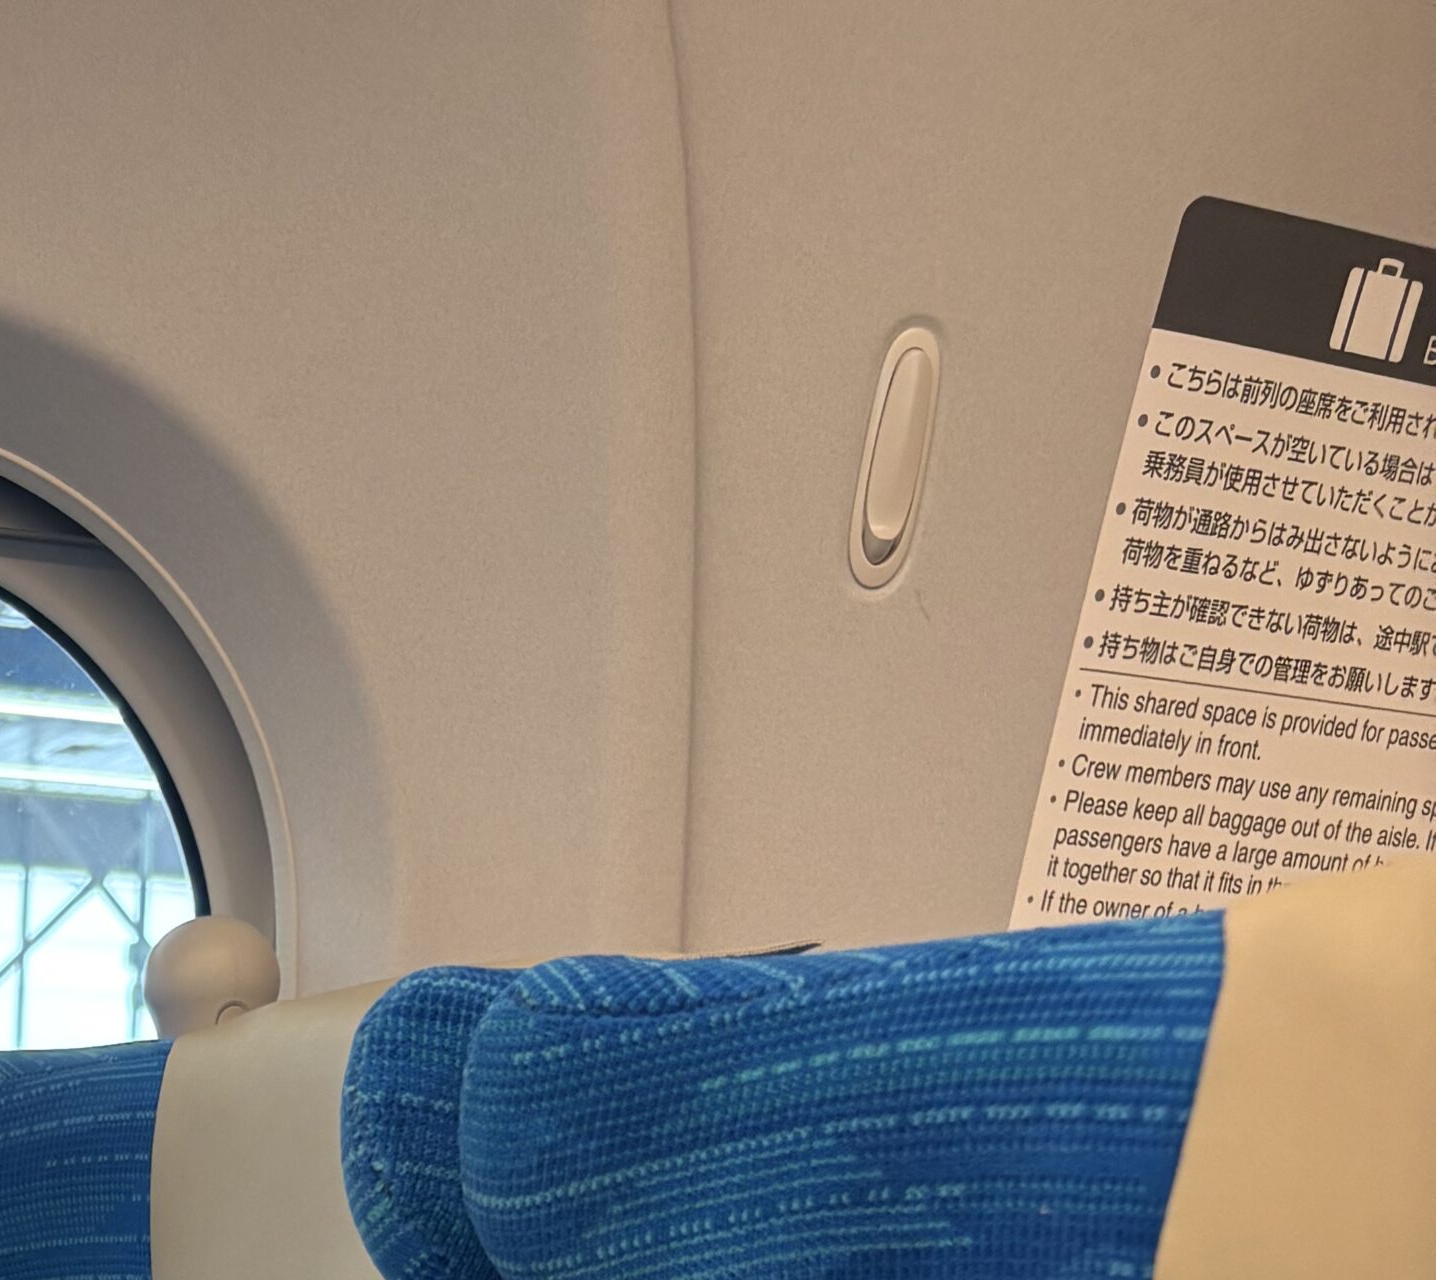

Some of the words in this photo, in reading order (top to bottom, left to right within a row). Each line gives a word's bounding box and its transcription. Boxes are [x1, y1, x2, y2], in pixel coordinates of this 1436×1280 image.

[1109, 583, 1436, 657] 持ち主が確認できない荷物は、途中駅
[1079, 718, 1192, 756] immediately
[1195, 731, 1212, 754] in
[1217, 734, 1260, 760] front.
[1091, 684, 1129, 710] This
[1134, 690, 1200, 718] shared
[1202, 704, 1256, 727] space
[1262, 706, 1277, 729] is
[1280, 714, 1358, 739] provided
[1361, 718, 1385, 743] for
[1072, 754, 1122, 780] Crew
[1125, 765, 1212, 790] members
[1216, 776, 1256, 801] may
[1259, 781, 1291, 800] use
[1296, 785, 1329, 810] any
[1332, 789, 1418, 820] remaining
[1064, 790, 1128, 817] Please
[1133, 797, 1178, 828] keep
[1182, 804, 1205, 826] all
[1208, 805, 1286, 839] baggage
[1291, 818, 1320, 838] out
[1324, 819, 1343, 840] of
[1346, 821, 1372, 844] the
[1377, 826, 1419, 849] aisle.
[1047, 854, 1059, 877] it
[1063, 858, 1138, 886] together
[1140, 869, 1162, 886] so
[1167, 866, 1200, 890] that
[1203, 870, 1215, 892] it
[1218, 871, 1243, 894] fits
[1246, 874, 1262, 895] in
[1267, 876, 1290, 894] th
[1053, 828, 1163, 857] passengers
[1167, 834, 1211, 859] have
[1216, 844, 1227, 861] a
[1232, 840, 1277, 870] large
[1282, 851, 1348, 872] amount
[1041, 889, 1055, 912] If
[1058, 892, 1088, 914] the
[1093, 900, 1150, 917] owner
